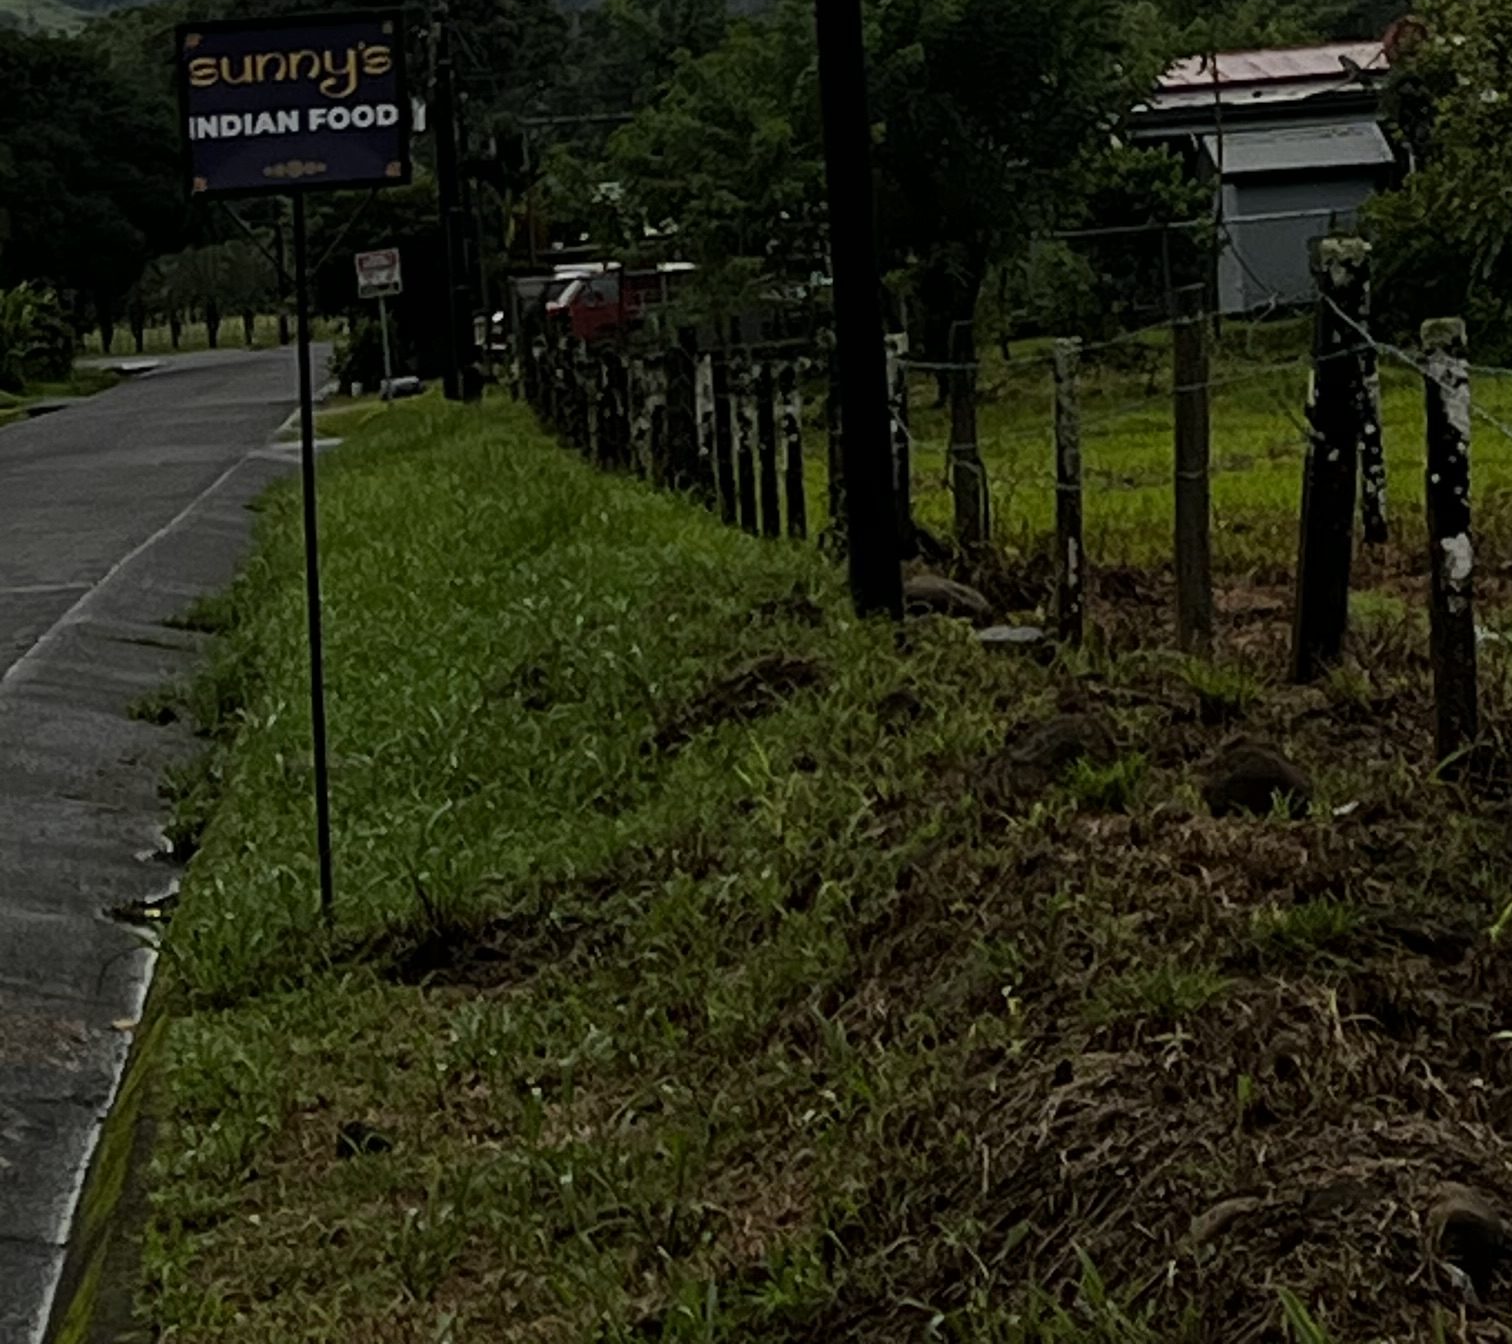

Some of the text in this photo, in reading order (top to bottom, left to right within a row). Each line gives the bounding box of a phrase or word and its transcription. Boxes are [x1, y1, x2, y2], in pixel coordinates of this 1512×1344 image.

[188, 41, 392, 99] sunny's
[188, 103, 399, 141] INDIAN FOOD
